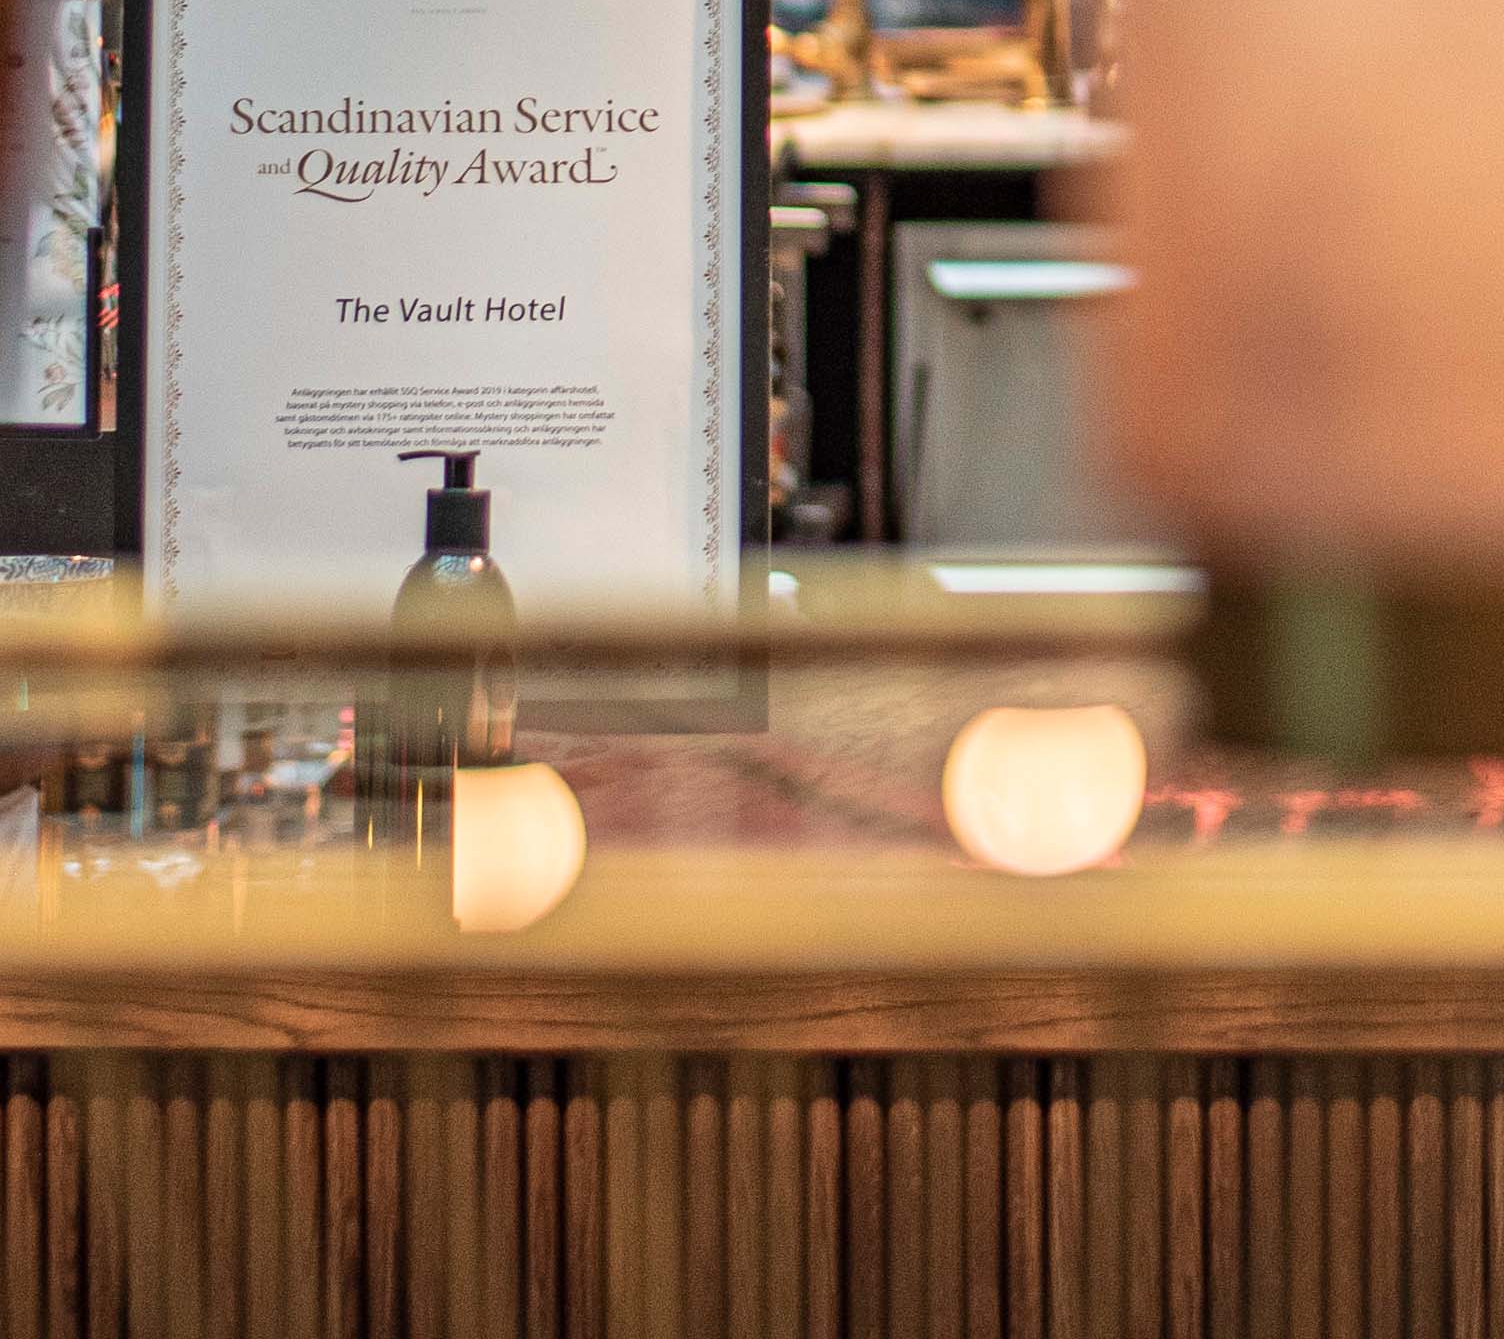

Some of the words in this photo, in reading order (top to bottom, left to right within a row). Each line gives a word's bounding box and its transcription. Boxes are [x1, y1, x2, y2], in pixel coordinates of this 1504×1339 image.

[230, 97, 502, 135] Scandinavian
[514, 96, 660, 134] Service
[257, 157, 291, 175] and
[293, 147, 448, 203] Quality
[336, 298, 390, 323] The
[399, 297, 475, 323] Vault
[484, 295, 566, 322] Hotel
[353, 387, 369, 395] har
[419, 387, 450, 395] Service
[451, 387, 480, 395] Award
[481, 386, 502, 395] 2019
[319, 401, 330, 411] på
[333, 401, 366, 411] mystery
[368, 401, 408, 410] shopping
[457, 400, 485, 410] e-post
[474, 413, 509, 422] Mystery
[510, 413, 562, 422] shoppingen
[532, 425, 591, 434] anläggningen
